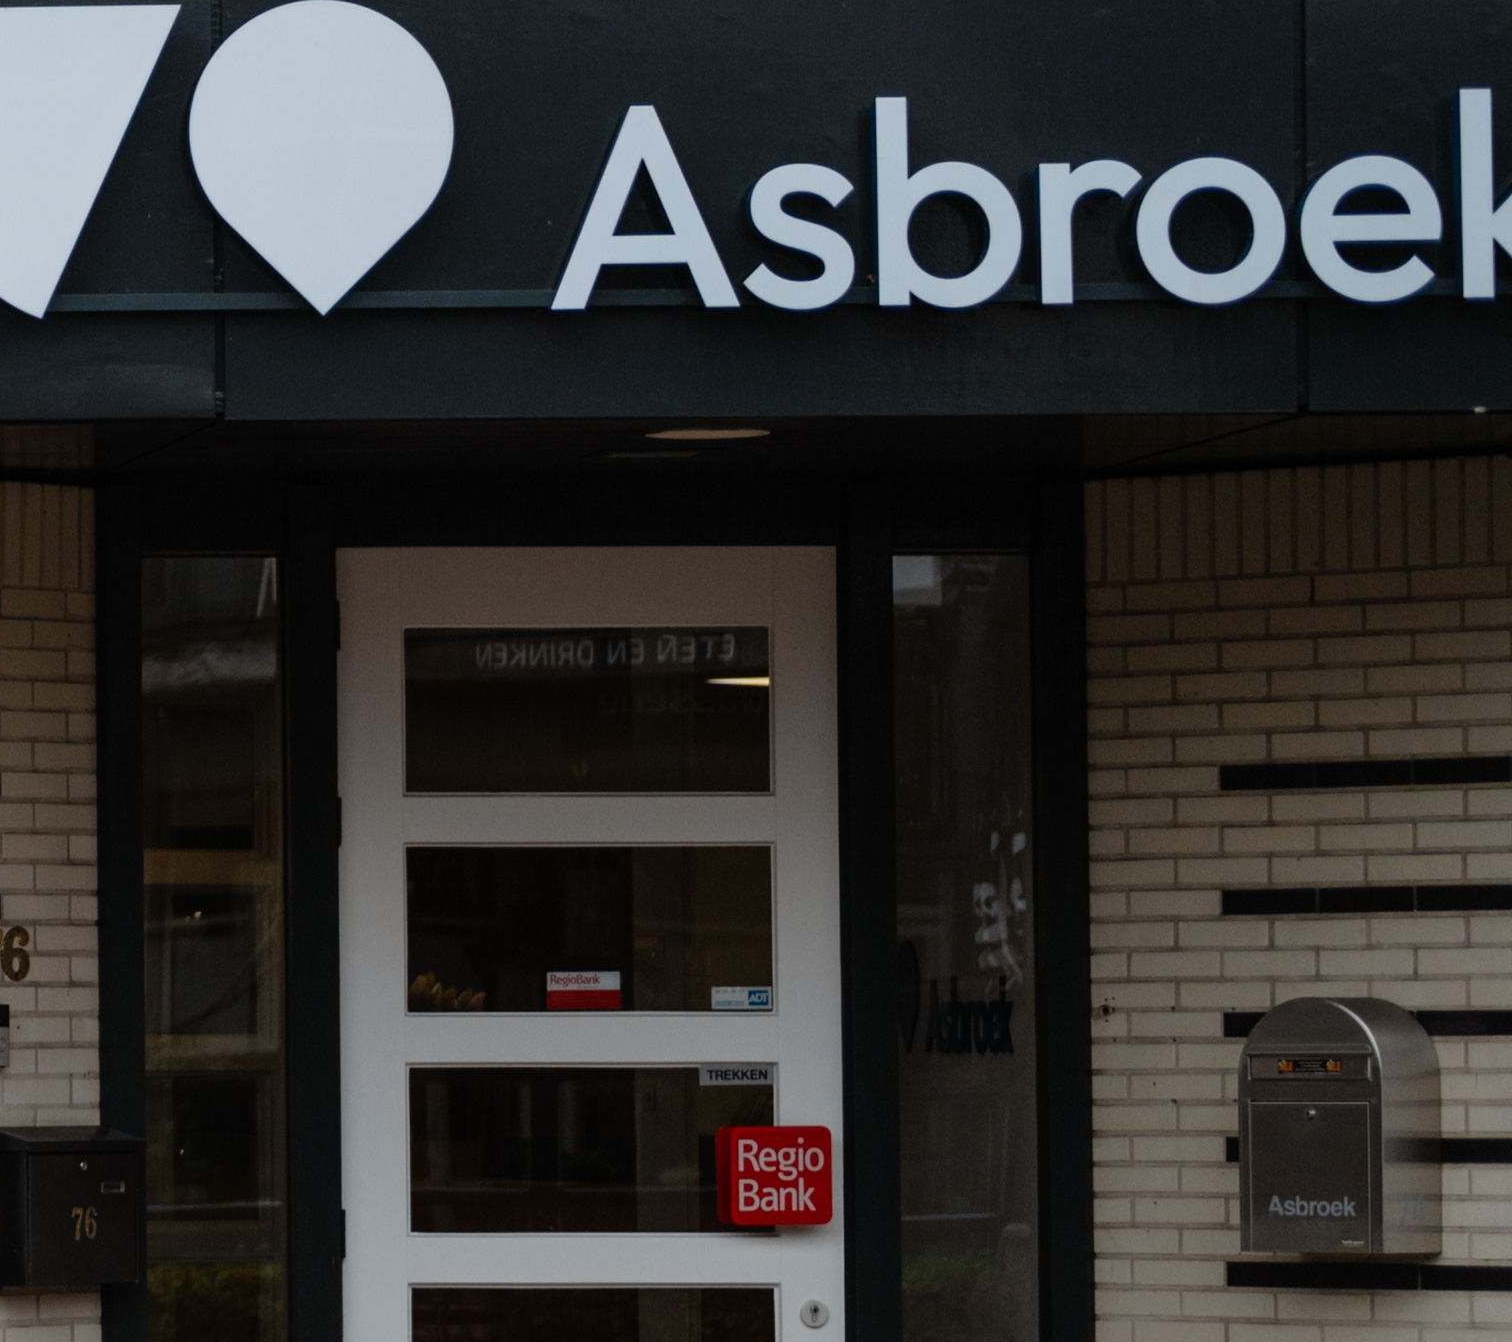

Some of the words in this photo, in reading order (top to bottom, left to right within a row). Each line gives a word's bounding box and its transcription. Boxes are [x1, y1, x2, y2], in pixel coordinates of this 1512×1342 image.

[550, 974, 600, 986] RegioBank
[748, 992, 768, 1003] ADT
[706, 1069, 768, 1081] TREKKEN
[736, 1137, 824, 1181] Regio
[737, 1178, 816, 1212] Bank
[1268, 1194, 1356, 1216] Asbroek
[71, 1207, 98, 1241] 76
